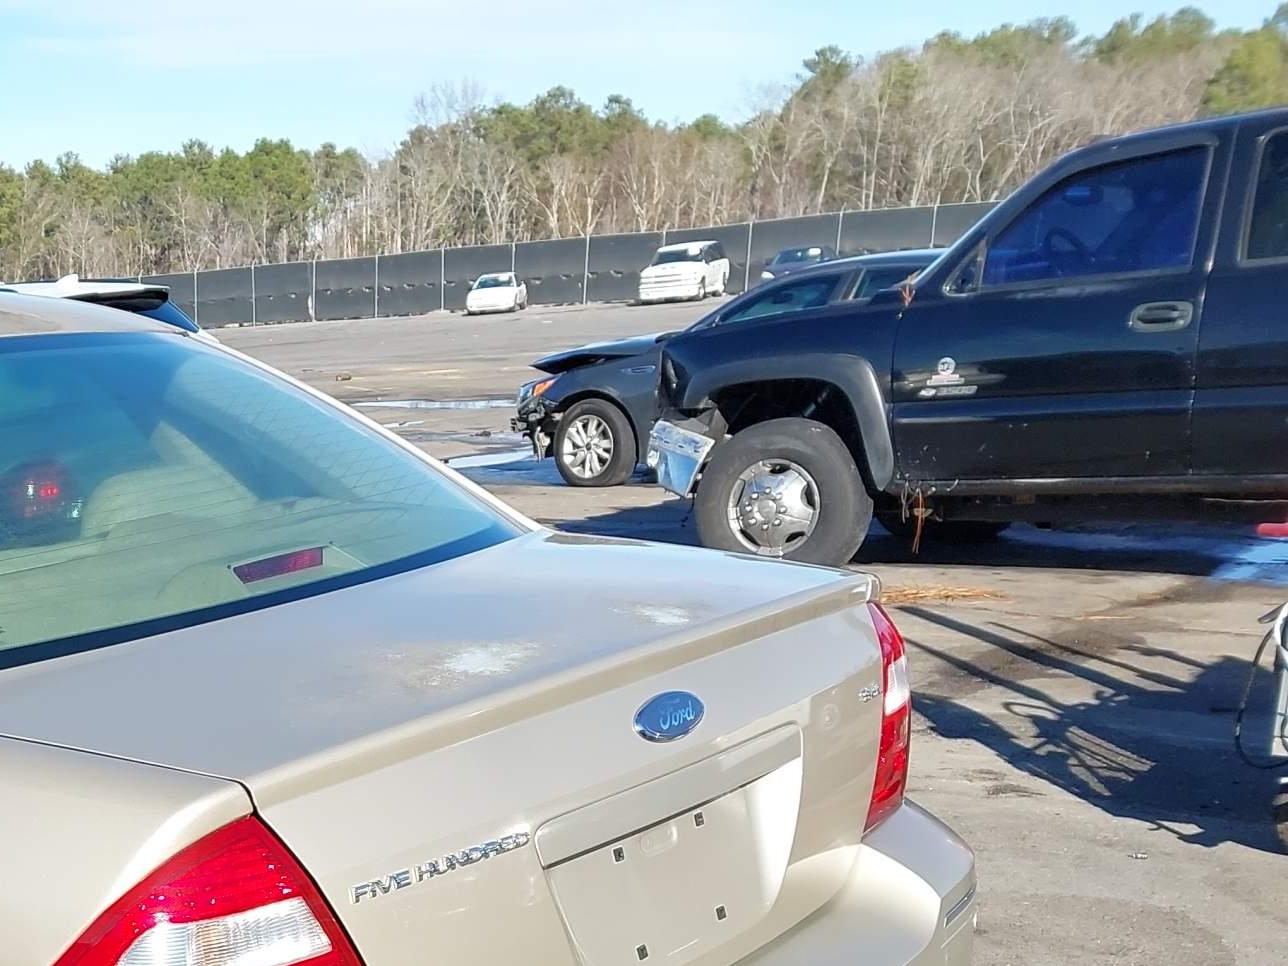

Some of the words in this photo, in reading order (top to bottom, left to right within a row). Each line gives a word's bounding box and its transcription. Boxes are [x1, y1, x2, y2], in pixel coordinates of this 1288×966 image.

[659, 698, 696, 730] Ford
[349, 868, 412, 904] FIVE
[413, 832, 531, 883] HUNDRED
